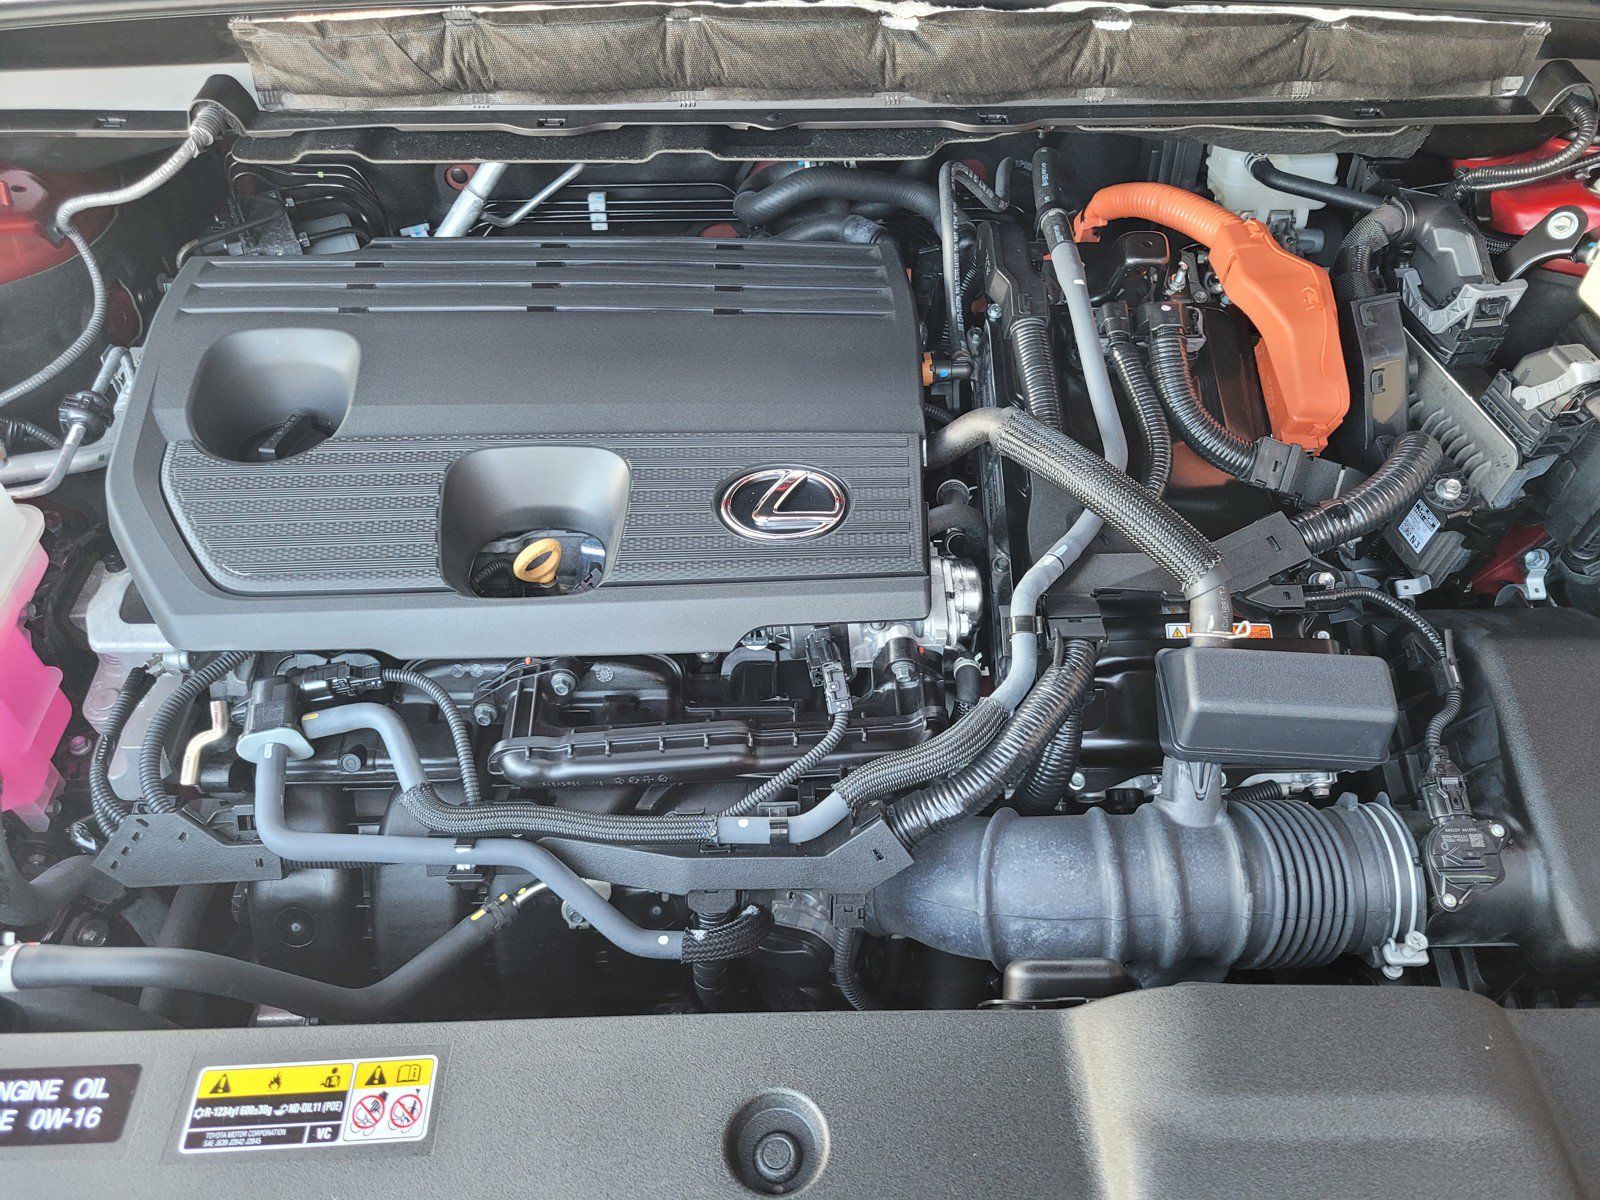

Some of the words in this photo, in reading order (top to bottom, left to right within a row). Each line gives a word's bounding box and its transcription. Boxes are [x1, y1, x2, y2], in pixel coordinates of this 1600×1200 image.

[1410, 535, 1421, 549] N3
[72, 1076, 110, 1100] OIL
[204, 1106, 240, 1118] R-1234yf
[288, 1102, 322, 1114] ND-OIL11
[322, 1100, 343, 1114] (POE)
[28, 1106, 103, 1131] 0W-16
[205, 1131, 227, 1139] TOYOTA
[227, 1130, 247, 1138] MOTOR
[247, 1129, 287, 1137] CORPORATION
[315, 1127, 333, 1140] VC
[203, 1139, 215, 1147] SAE
